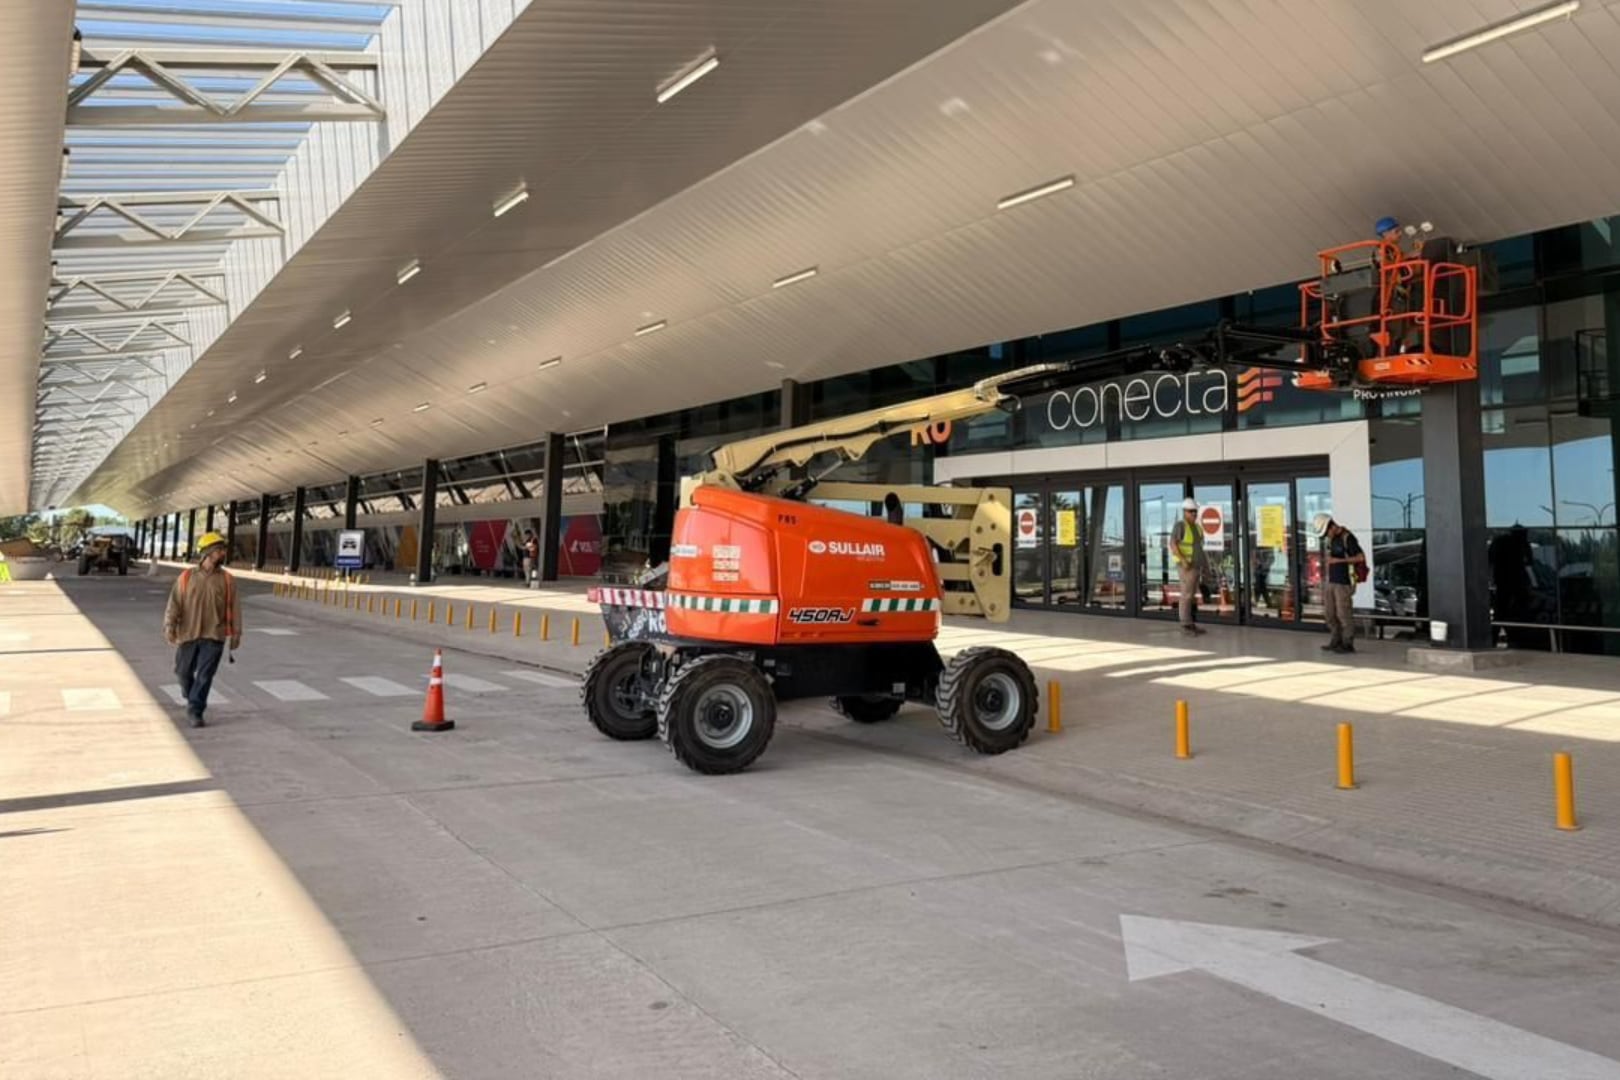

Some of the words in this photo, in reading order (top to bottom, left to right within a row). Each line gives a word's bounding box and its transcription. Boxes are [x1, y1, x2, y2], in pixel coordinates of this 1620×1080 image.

[1047, 369, 1228, 430] conecta
[829, 541, 885, 556] SULLAIR
[788, 607, 855, 624] 450AJ
